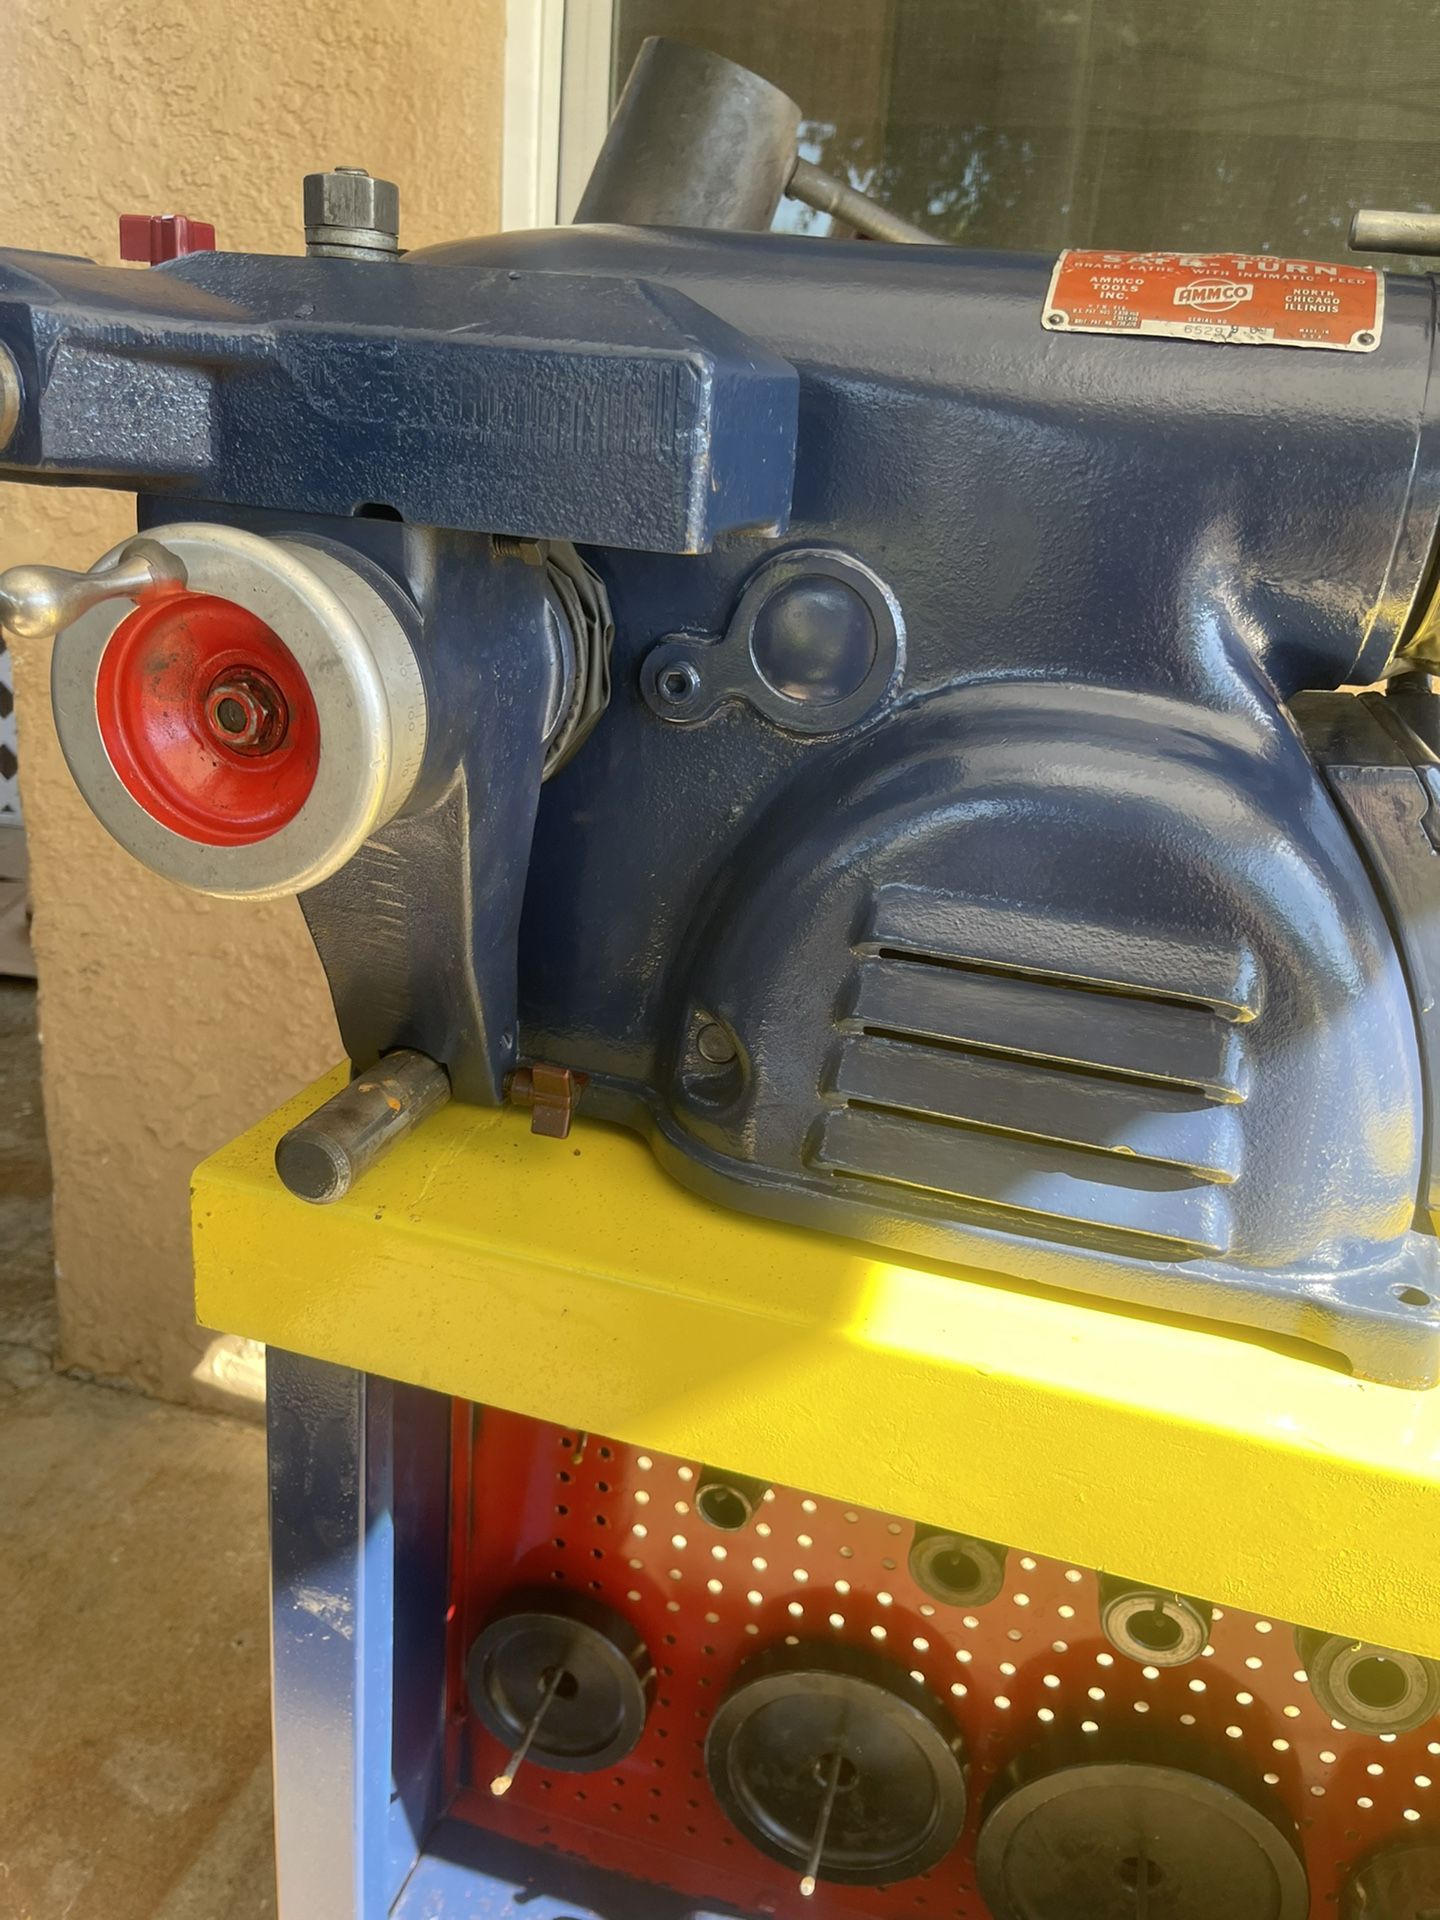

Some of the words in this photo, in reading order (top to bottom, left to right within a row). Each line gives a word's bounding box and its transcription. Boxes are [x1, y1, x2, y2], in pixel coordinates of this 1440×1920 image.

[1089, 276, 1144, 285] AMMCO
[1192, 267, 1229, 276] WITH
[1329, 277, 1366, 285] FEED
[1092, 283, 1138, 292] TOOLS
[1099, 291, 1129, 300] INC.
[1178, 286, 1248, 302] AMMCO
[1293, 288, 1335, 297] NORTH
[1285, 295, 1340, 305] CHICAGO
[1285, 303, 1339, 313] ILLINOIS
